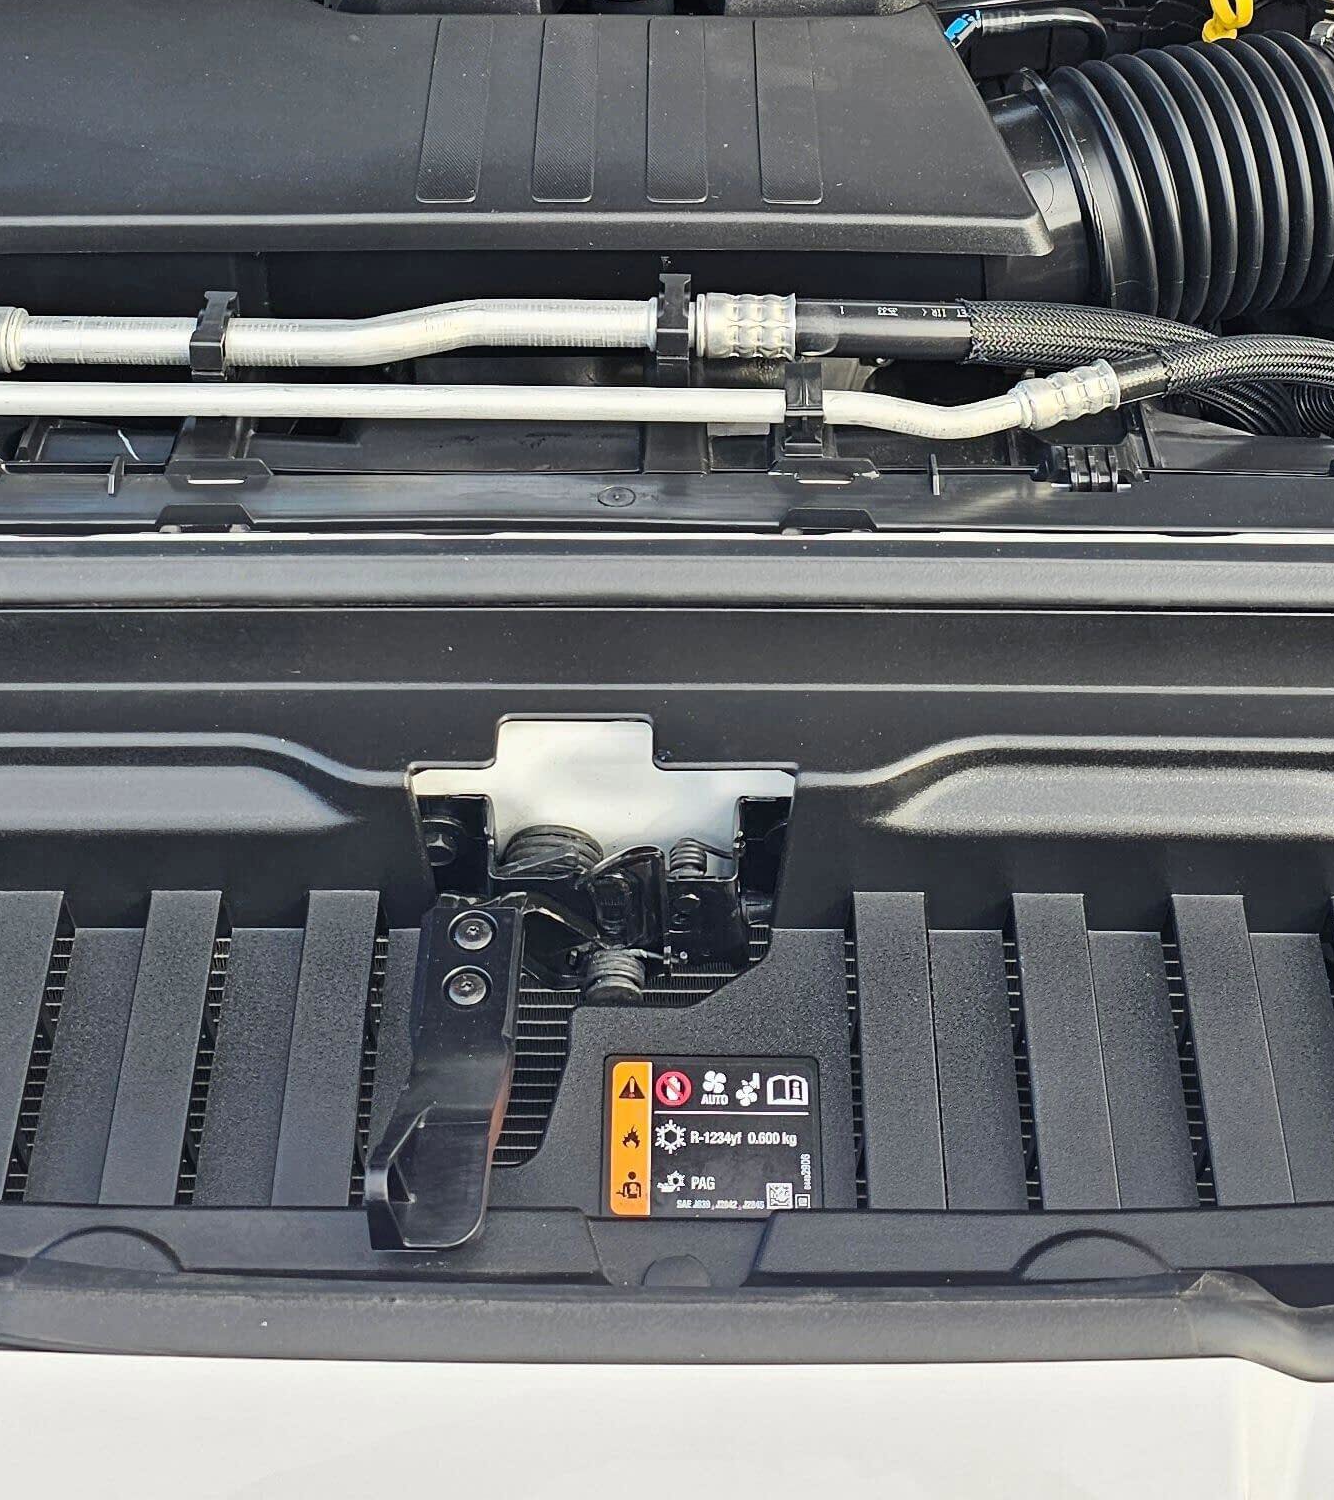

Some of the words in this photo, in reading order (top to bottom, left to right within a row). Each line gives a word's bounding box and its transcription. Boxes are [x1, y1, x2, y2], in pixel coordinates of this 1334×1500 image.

[701, 1094, 729, 1106] AUTO
[690, 1131, 742, 1146] R-1234yf
[747, 1132, 780, 1145] 0.600
[782, 1132, 798, 1146] kg
[691, 1176, 716, 1191] PAG
[676, 1200, 692, 1209] SAE
